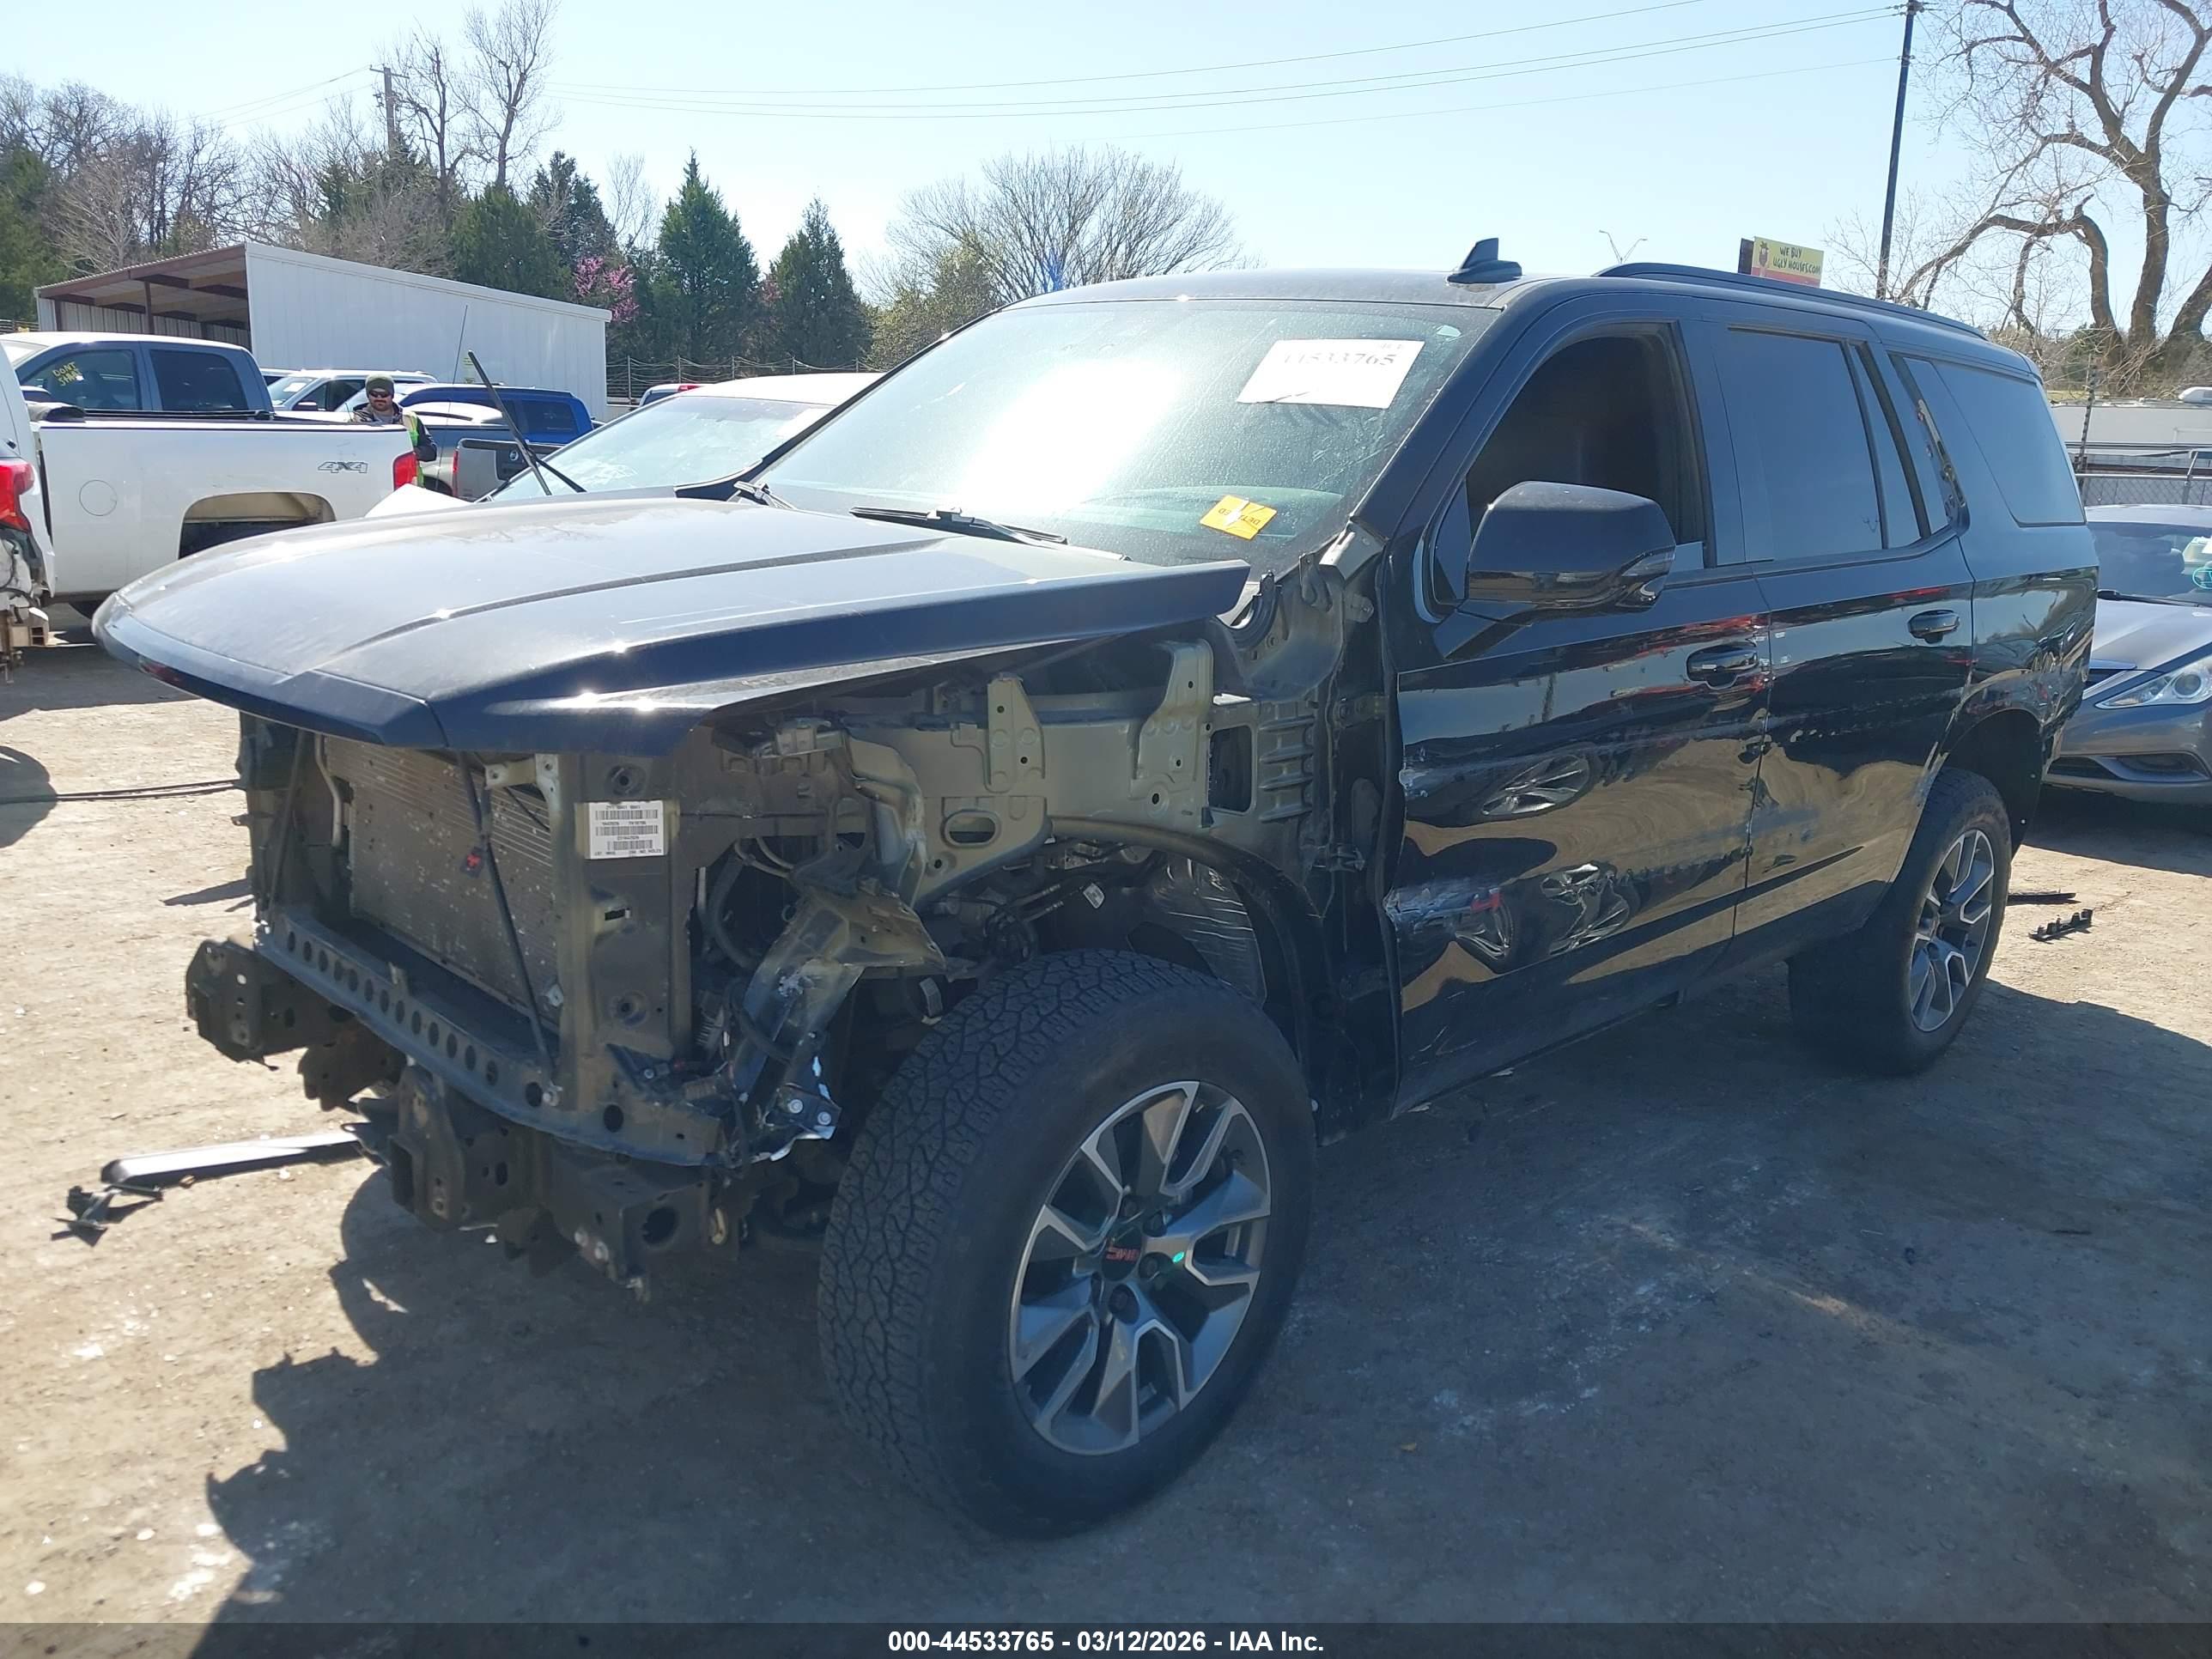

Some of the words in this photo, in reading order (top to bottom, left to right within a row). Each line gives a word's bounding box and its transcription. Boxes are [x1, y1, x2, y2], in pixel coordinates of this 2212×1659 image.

[1779, 246, 1790, 257] WE
[1790, 246, 1802, 258] BUY
[1772, 256, 1788, 269] UGLY
[52, 362, 76, 376] DONT
[1218, 507, 1261, 526] DETED
